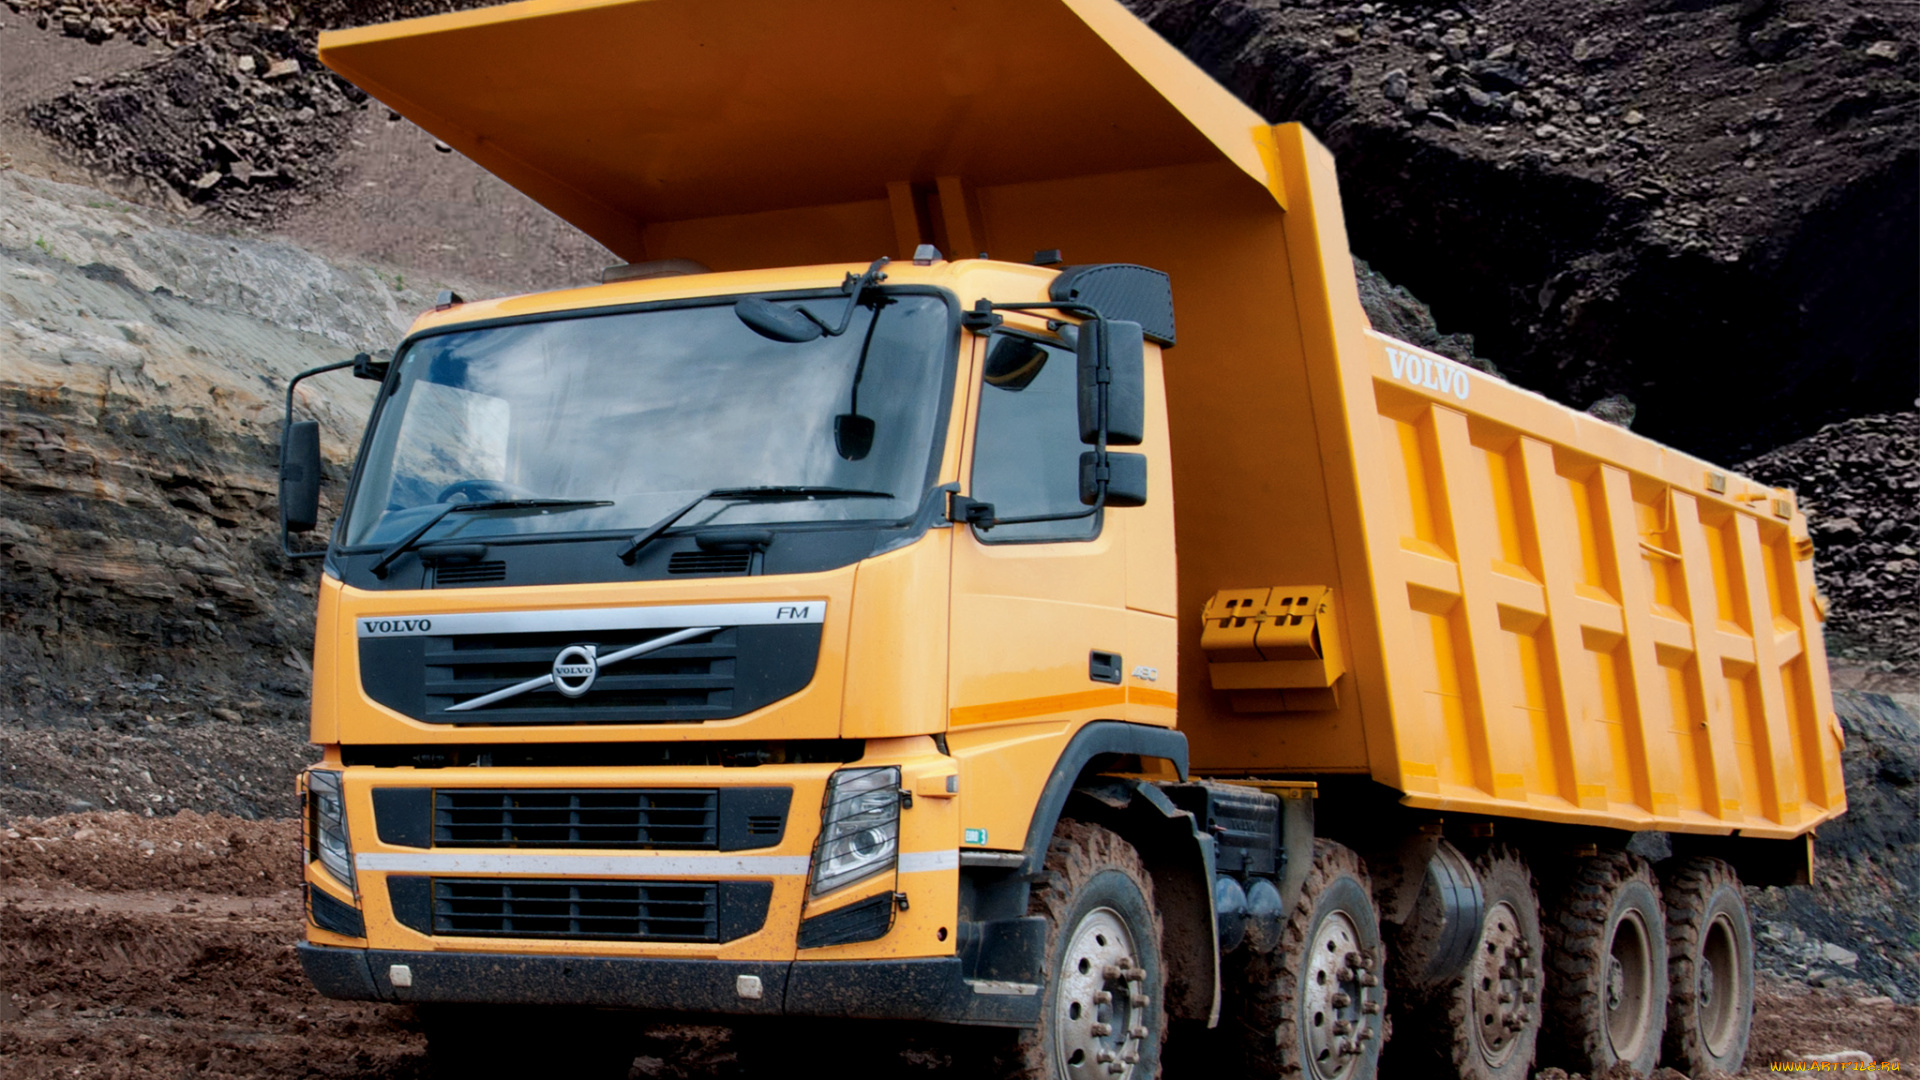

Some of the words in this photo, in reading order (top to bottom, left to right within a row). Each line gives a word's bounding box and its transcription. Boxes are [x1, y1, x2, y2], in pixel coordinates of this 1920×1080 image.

[1385, 346, 1470, 400] VOLVO
[776, 606, 809, 619] FM
[363, 619, 432, 633] VOLVO
